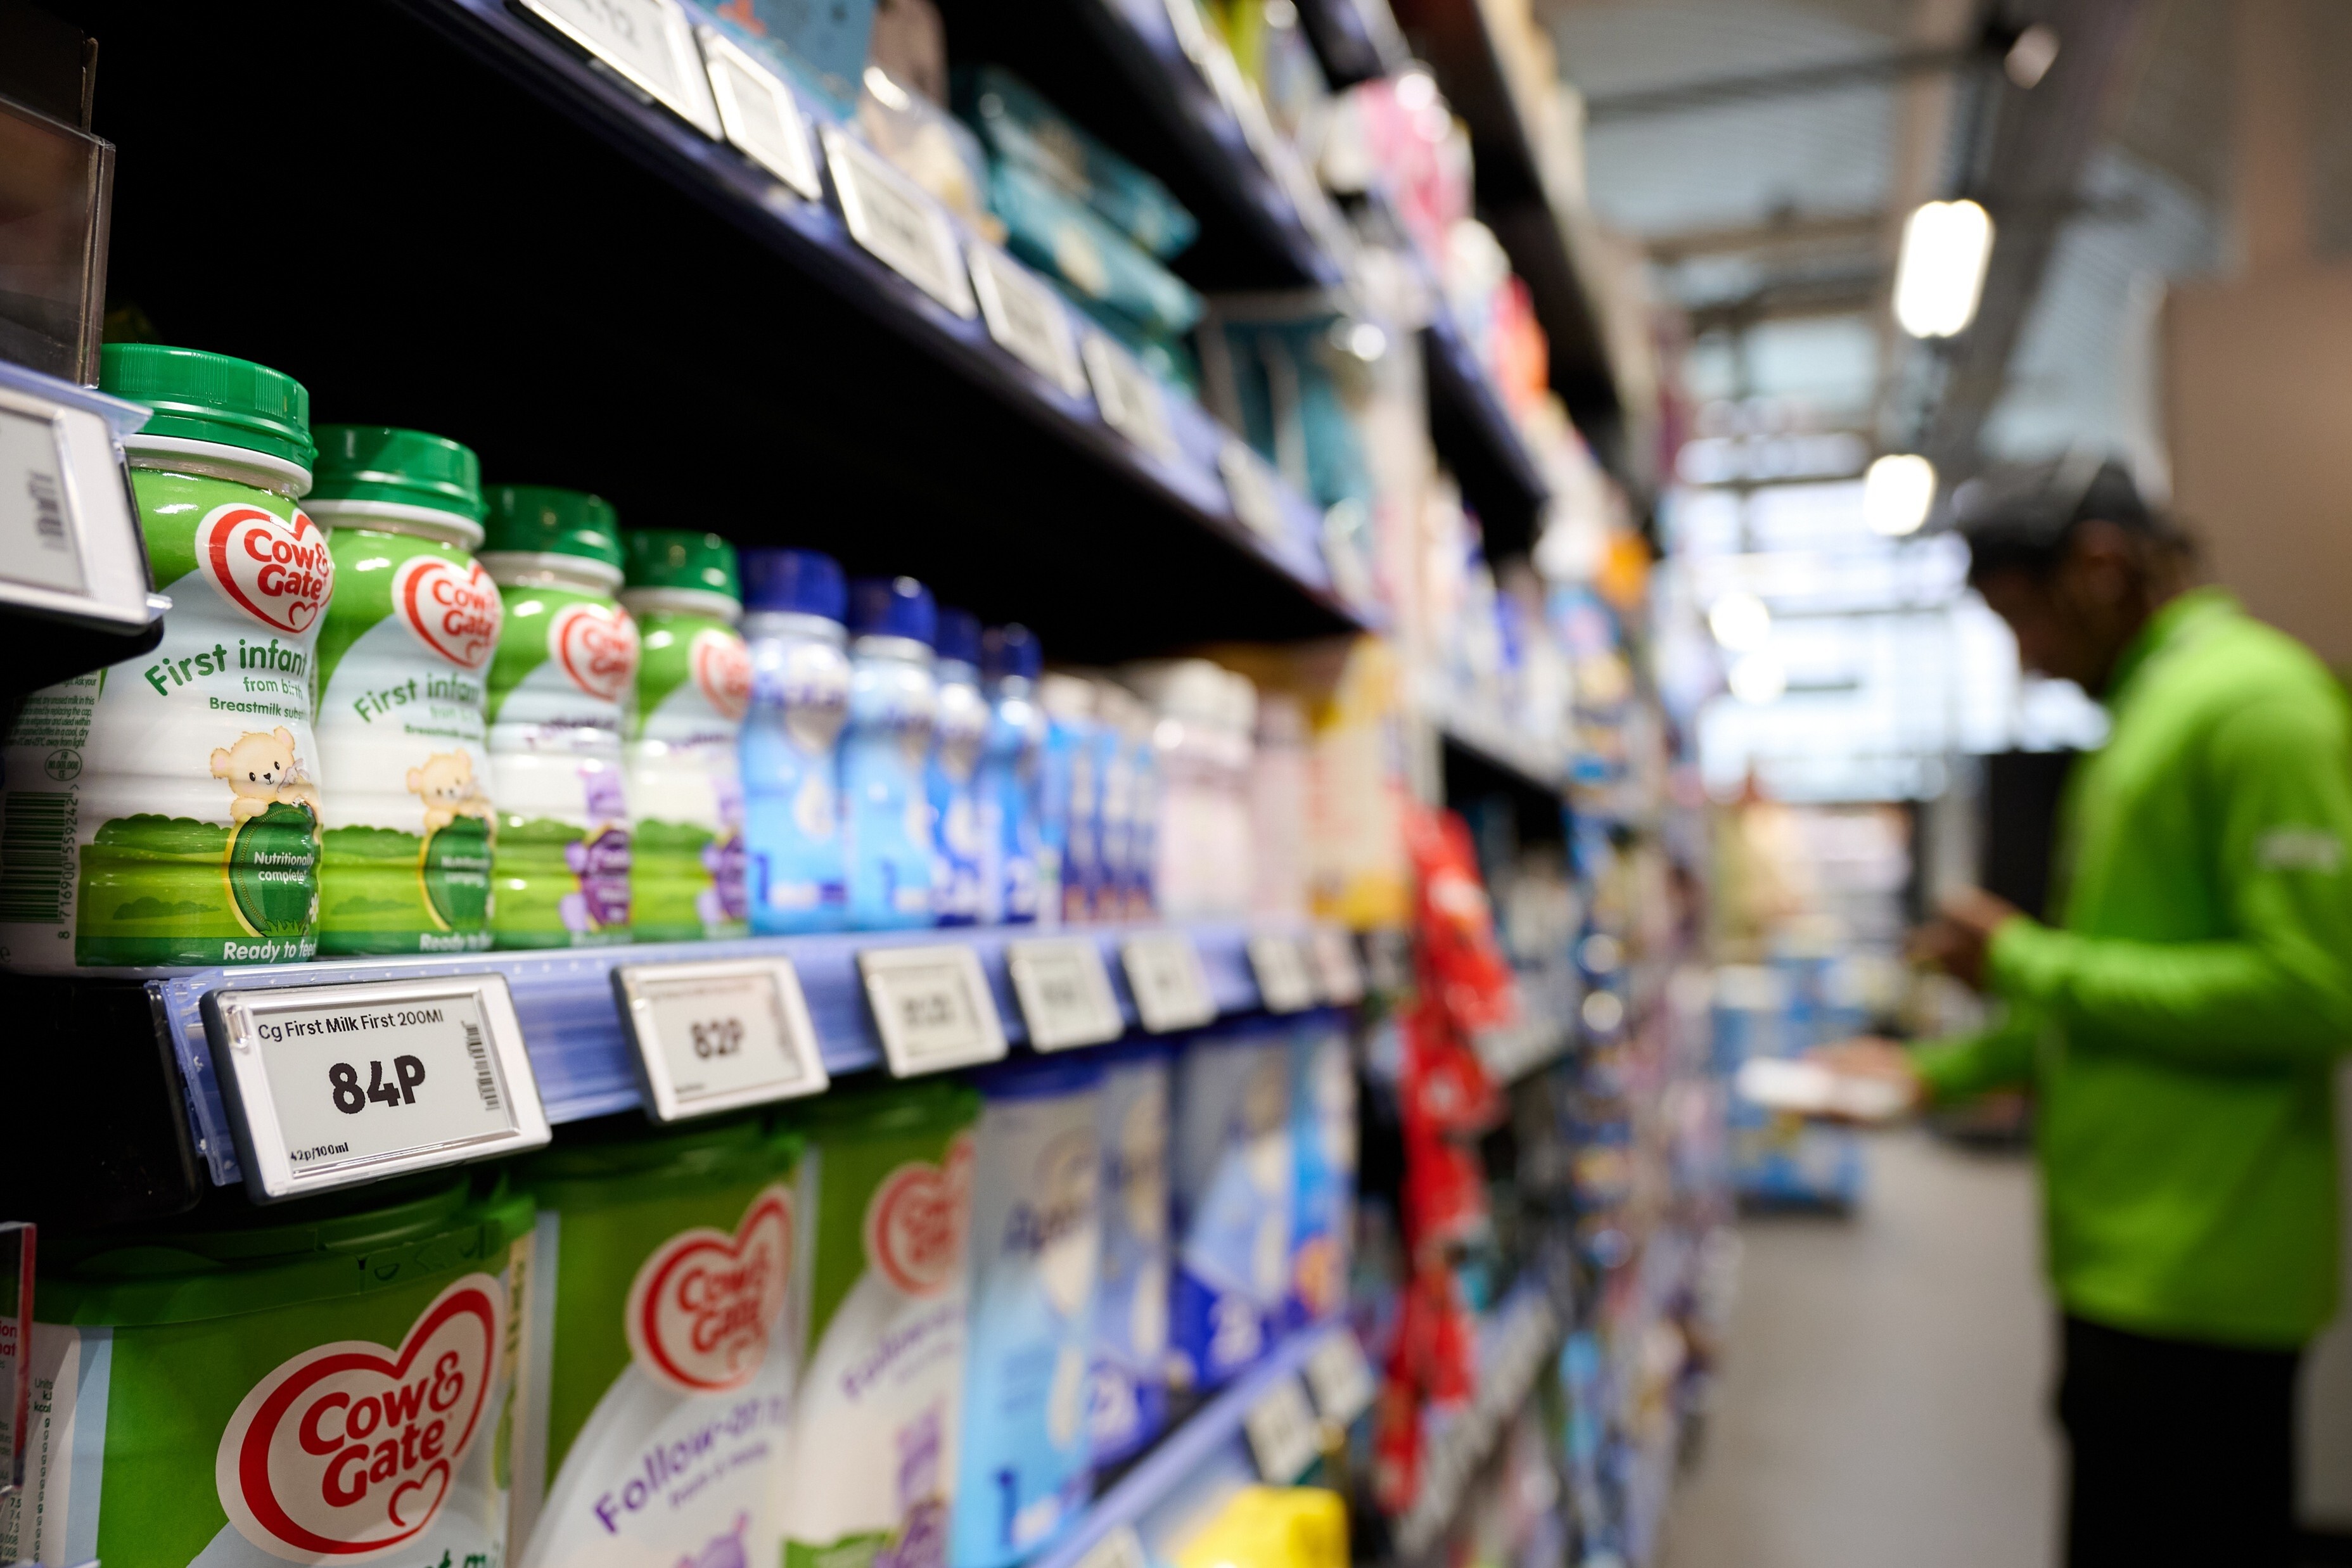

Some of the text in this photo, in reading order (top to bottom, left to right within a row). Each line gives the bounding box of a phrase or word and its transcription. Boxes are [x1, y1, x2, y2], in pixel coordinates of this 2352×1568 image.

[257, 564, 323, 600] Gate
[144, 639, 307, 696] First infant
[243, 676, 279, 692] from
[210, 697, 281, 717] Breastmilk
[353, 677, 417, 723] First
[58, 798, 78, 940] 8 716900 559242
[254, 851, 314, 868] Nutritionally
[223, 940, 280, 963] Ready
[283, 941, 297, 958] to
[258, 1024, 283, 1042] Cg
[284, 1019, 324, 1037] First
[326, 1016, 359, 1033] Milk
[360, 1012, 396, 1029] First
[328, 1054, 426, 1115] 84P
[290, 1142, 349, 1161] 42p/100ml
[34, 1401, 51, 1413] kcal
[322, 1417, 445, 1507] Gate
